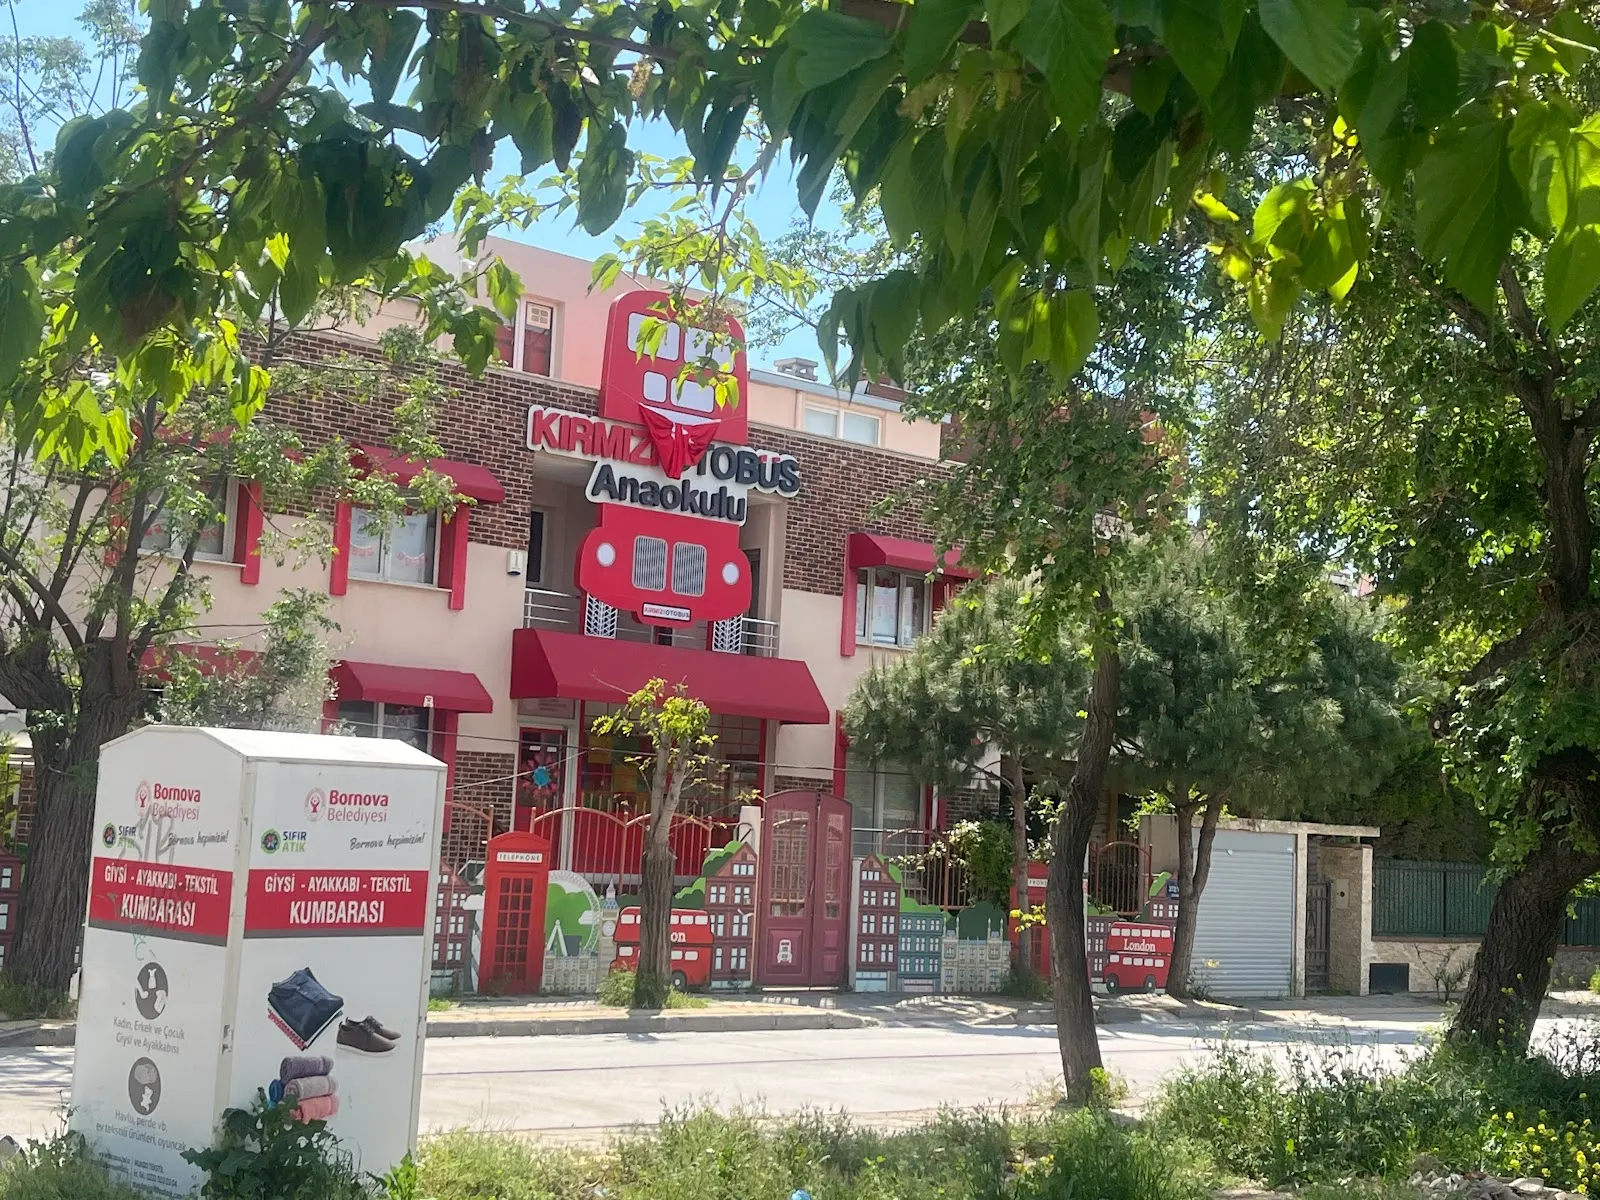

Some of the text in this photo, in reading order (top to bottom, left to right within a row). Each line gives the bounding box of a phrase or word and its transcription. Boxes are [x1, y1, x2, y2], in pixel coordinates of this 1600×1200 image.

[682, 444, 800, 493] TOBÜS
[591, 464, 746, 522] Anaokulu
[154, 783, 201, 803] Bornova
[329, 790, 389, 807] Bornova
[152, 803, 200, 822] Belediyesi
[327, 807, 388, 825] Belediyesi
[118, 825, 137, 837] SIFIR
[282, 831, 307, 842] SIFIR
[282, 841, 306, 853] ATIK
[350, 836, 384, 851] Bornova
[499, 853, 541, 862] TELEPHONE
[105, 863, 128, 884] GİYSİ
[136, 869, 177, 889] AYAKKABI
[185, 873, 219, 895] TEKSTİL
[265, 872, 295, 894] GİYSİ
[308, 876, 360, 893] AYAKKABI
[370, 873, 412, 893] TEKSTİL
[121, 894, 195, 926] KUMBARASI
[290, 900, 384, 925] KUMBARASI
[1123, 938, 1156, 952] London
[134, 1021, 152, 1033] Erkek
[154, 1026, 162, 1035] ve
[163, 1025, 185, 1040] Çocuk
[134, 1038, 142, 1047] ve
